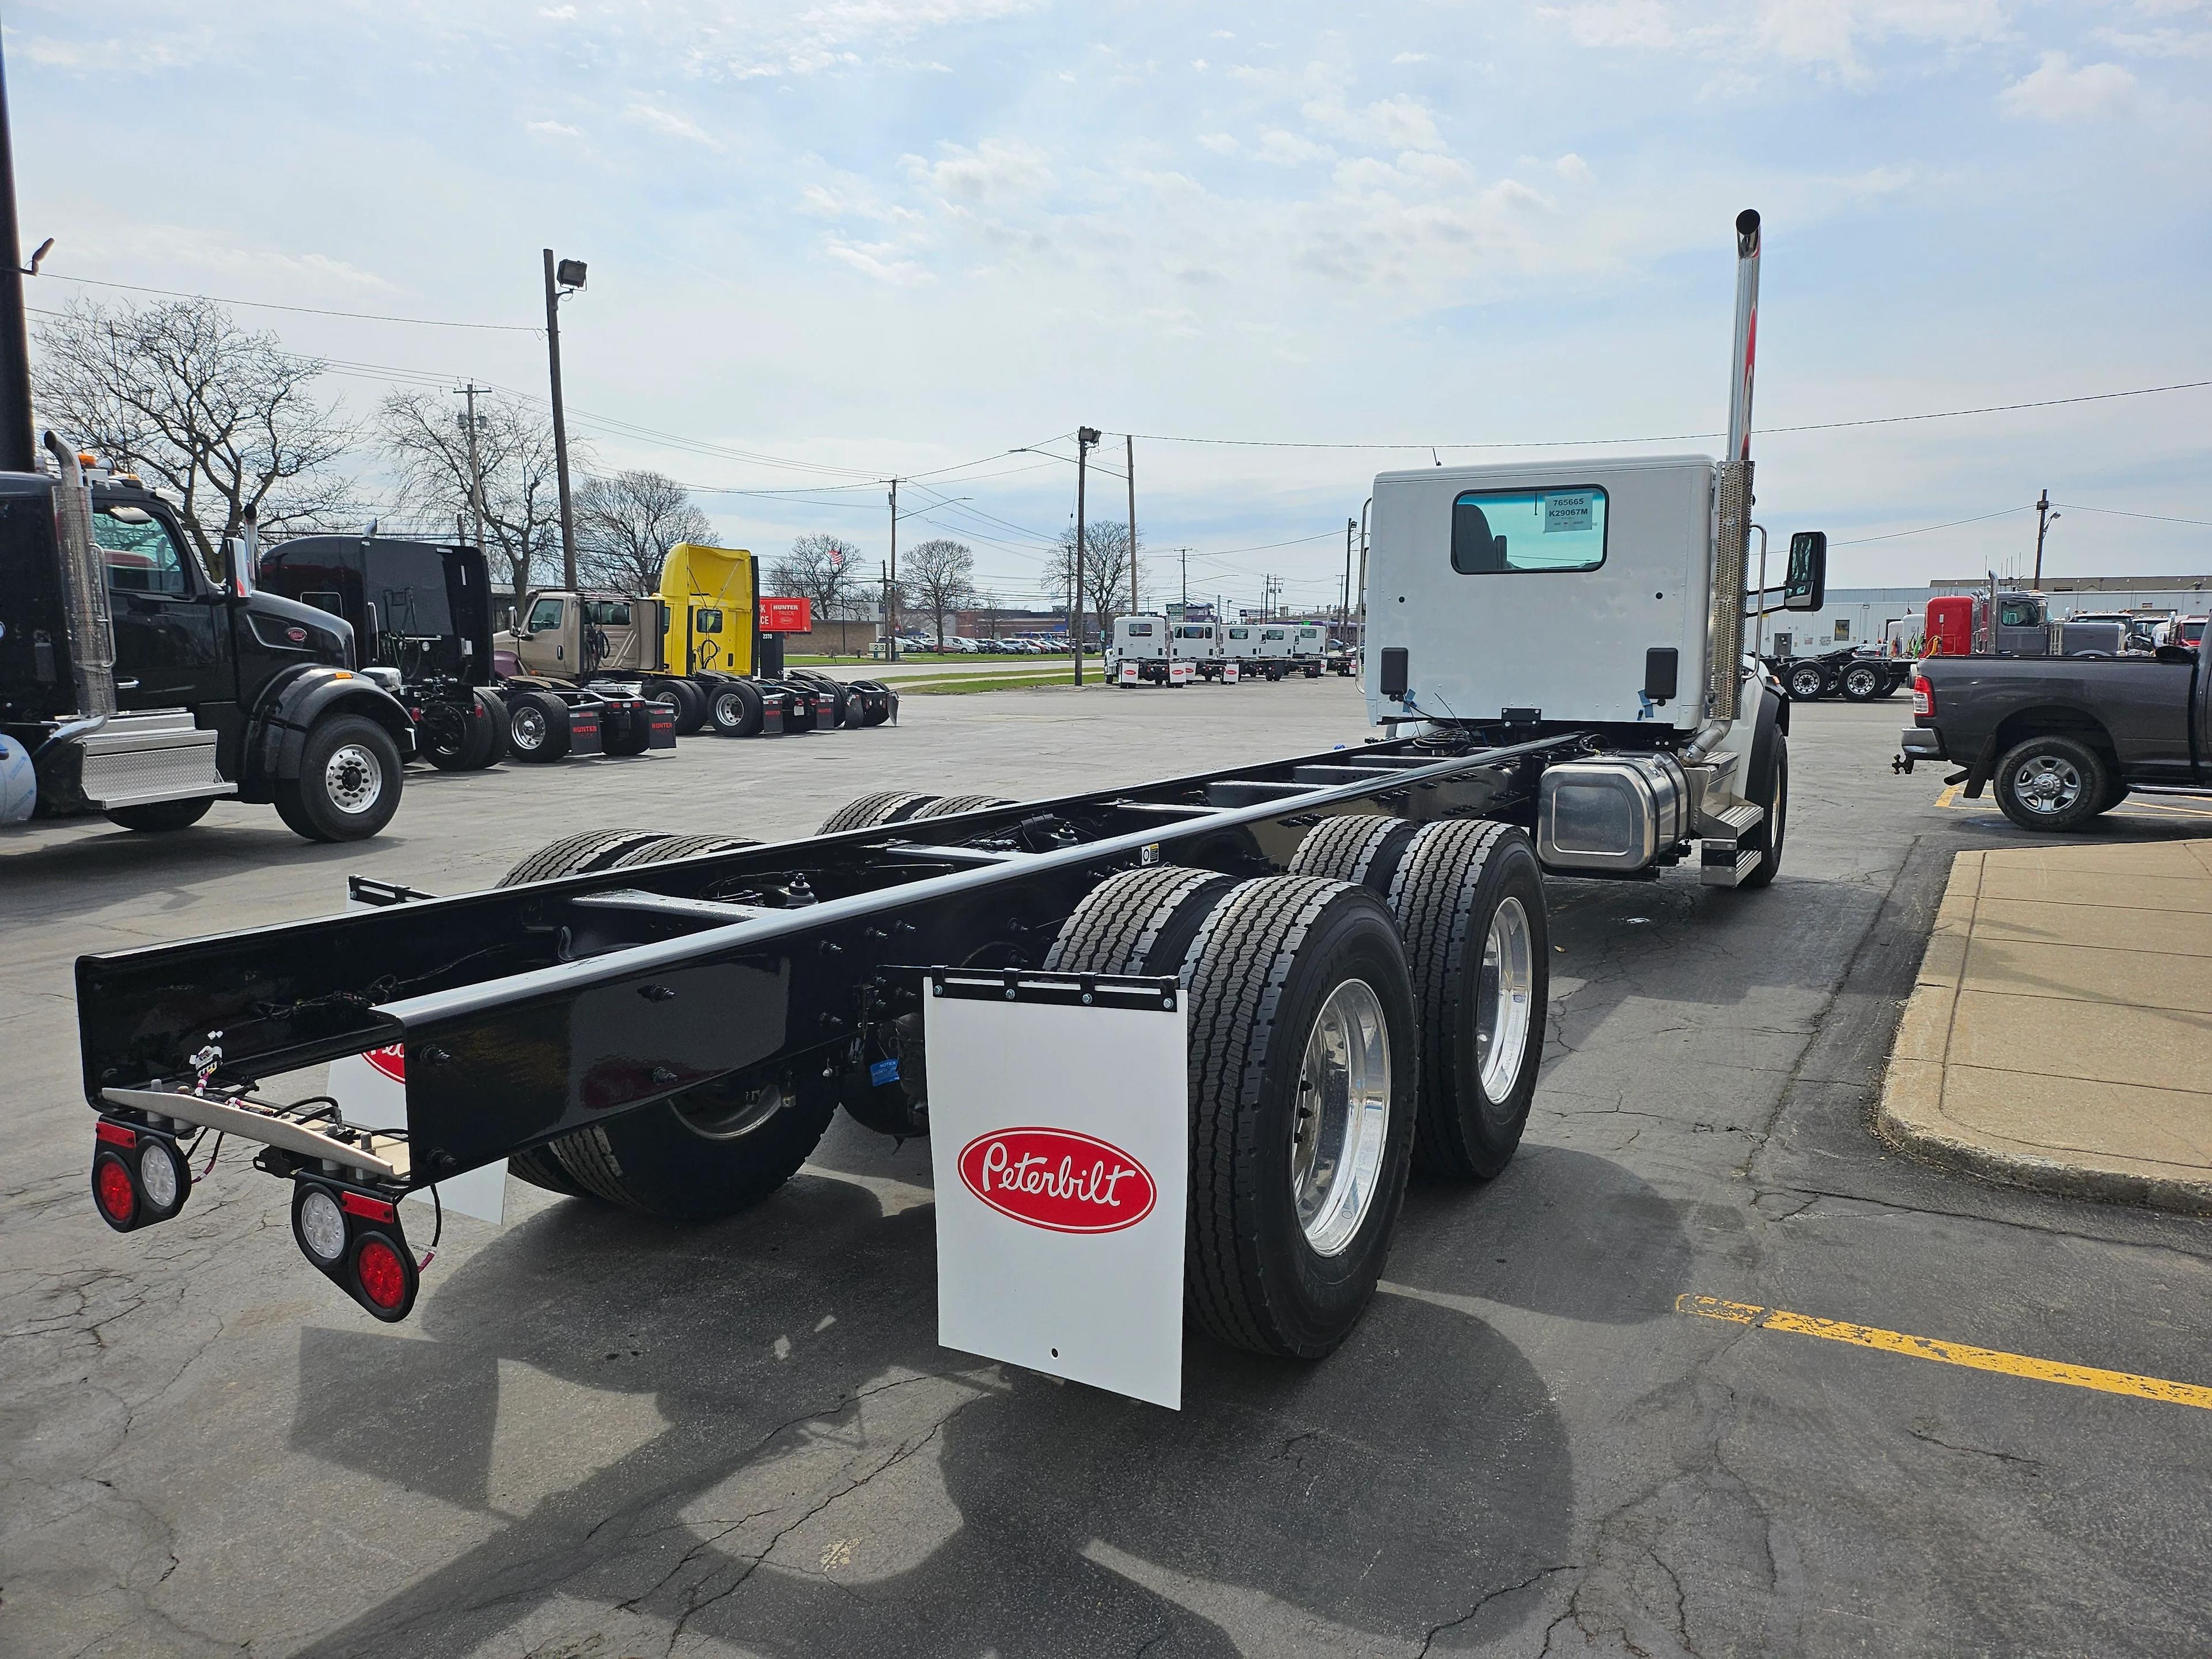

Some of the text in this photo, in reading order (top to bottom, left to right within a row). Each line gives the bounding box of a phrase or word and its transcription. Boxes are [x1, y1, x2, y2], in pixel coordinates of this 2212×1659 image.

[1553, 498, 1584, 506] 765665
[1549, 508, 1588, 517] K29067M
[573, 725, 597, 733] HUNTER
[982, 1142, 1137, 1206] Peterbilt
